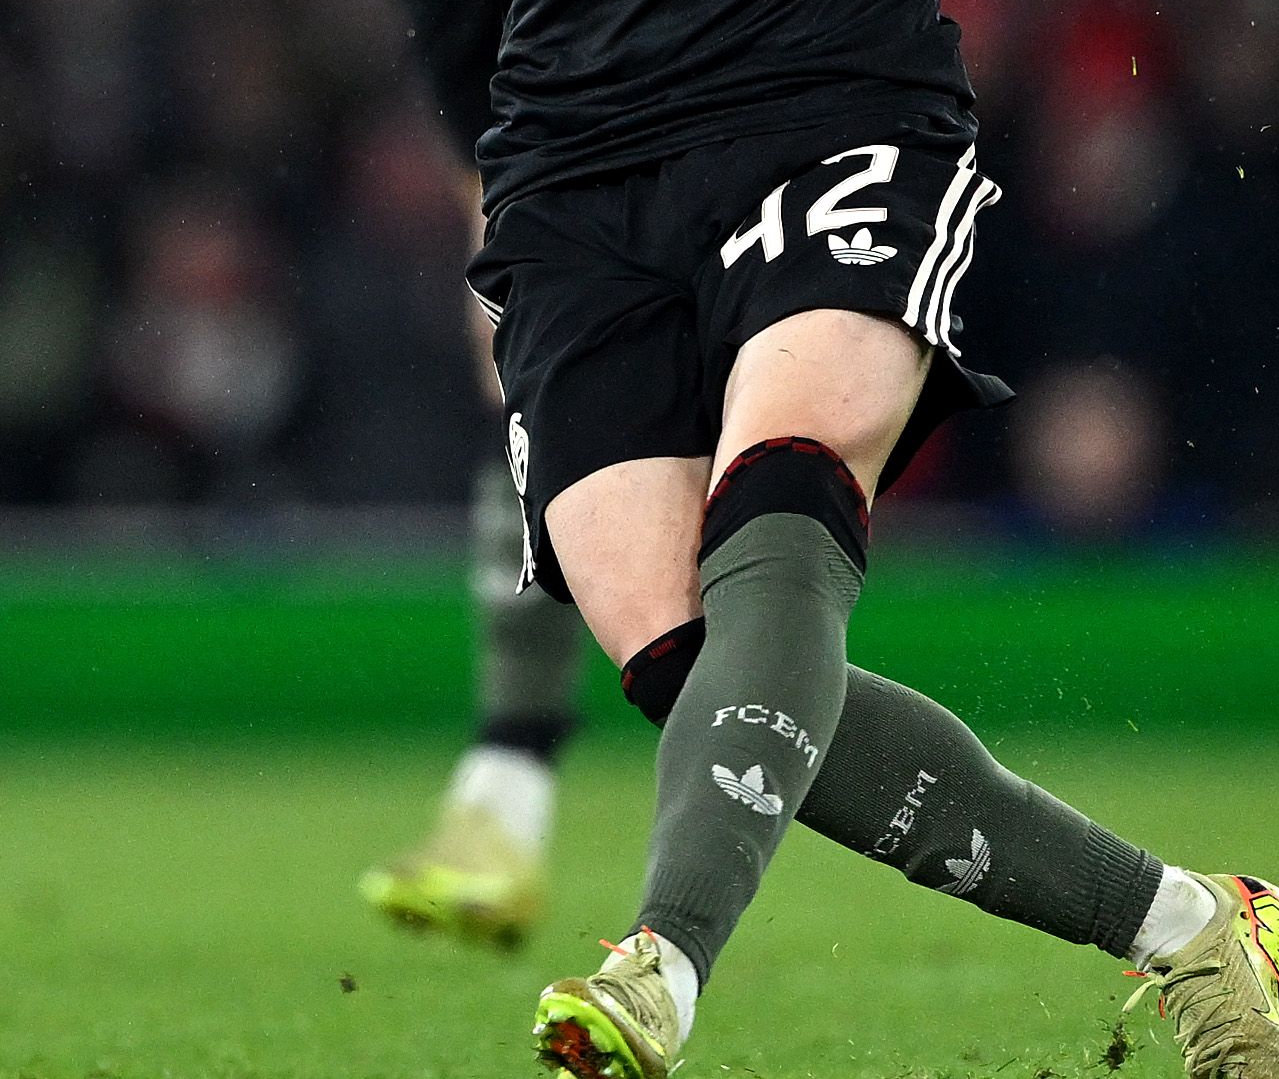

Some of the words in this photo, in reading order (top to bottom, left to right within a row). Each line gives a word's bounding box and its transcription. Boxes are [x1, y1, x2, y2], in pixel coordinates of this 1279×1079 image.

[720, 144, 900, 270] 42
[710, 704, 819, 769] FCBM
[863, 769, 939, 858] CBM
